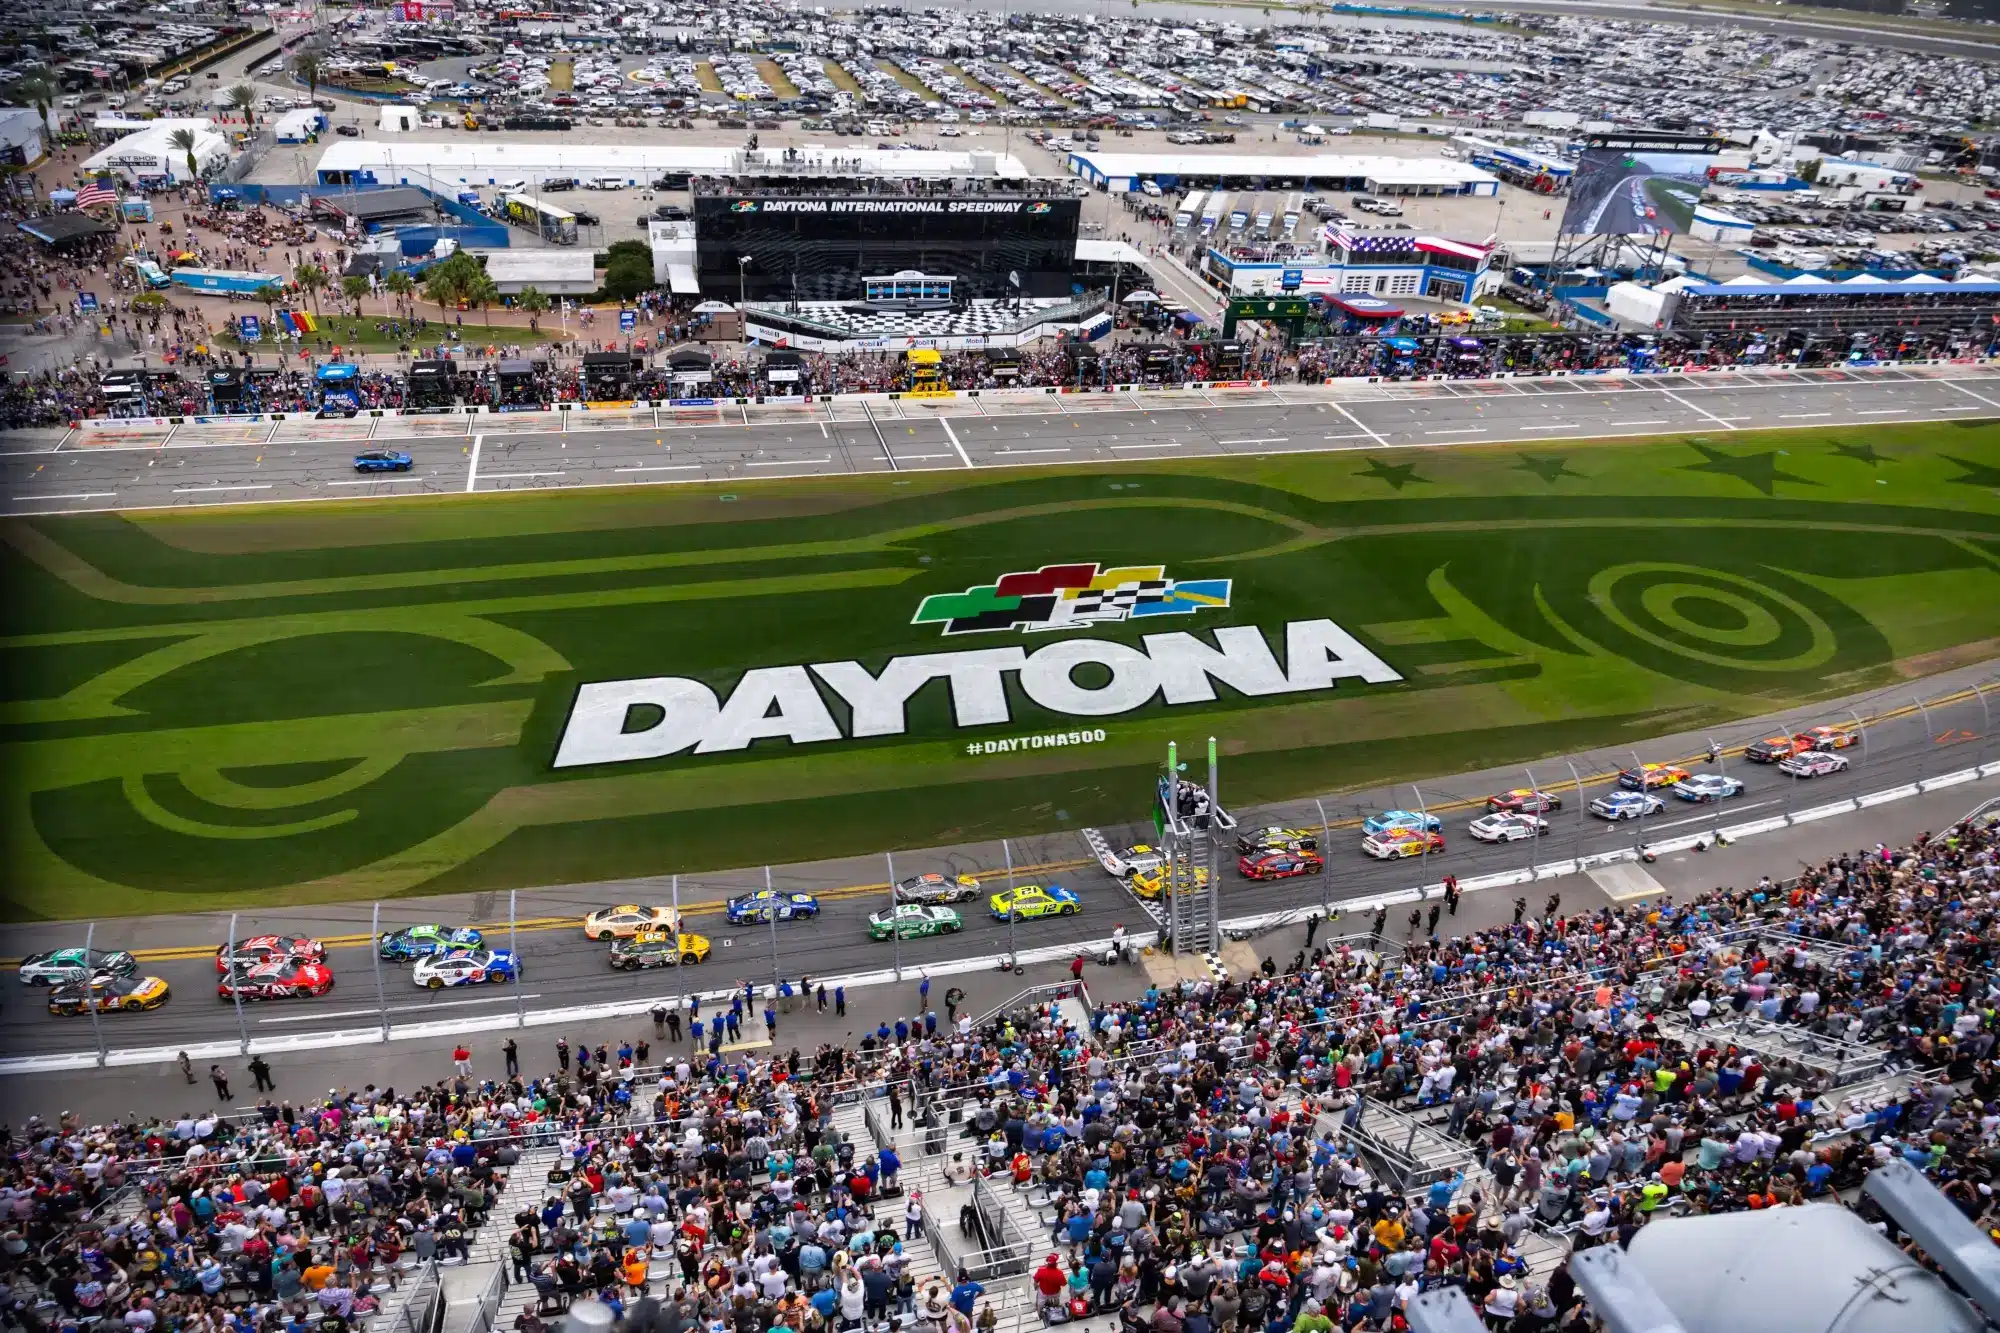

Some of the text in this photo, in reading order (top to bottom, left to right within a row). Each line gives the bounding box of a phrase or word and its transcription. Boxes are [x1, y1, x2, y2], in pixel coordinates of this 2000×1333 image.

[1606, 140, 1632, 148] DAYTONA
[1633, 141, 1676, 149] INTERNATIONAL
[763, 201, 1022, 213] DAYTONA INTERNATIONAL SPEEDWAY
[760, 328, 773, 336] Mobil
[554, 618, 1403, 768] DAYTONA
[966, 729, 1106, 755] #DAYTONA500
[949, 889, 958, 899] 3
[1043, 904, 1057, 914] 12
[634, 923, 652, 932] 40
[920, 922, 935, 933] 42
[470, 970, 484, 980] 51
[271, 984, 291, 995] 41
[108, 997, 119, 1008] 4
[524, 1138, 539, 1146] 348
[445, 1229, 461, 1238] 40
